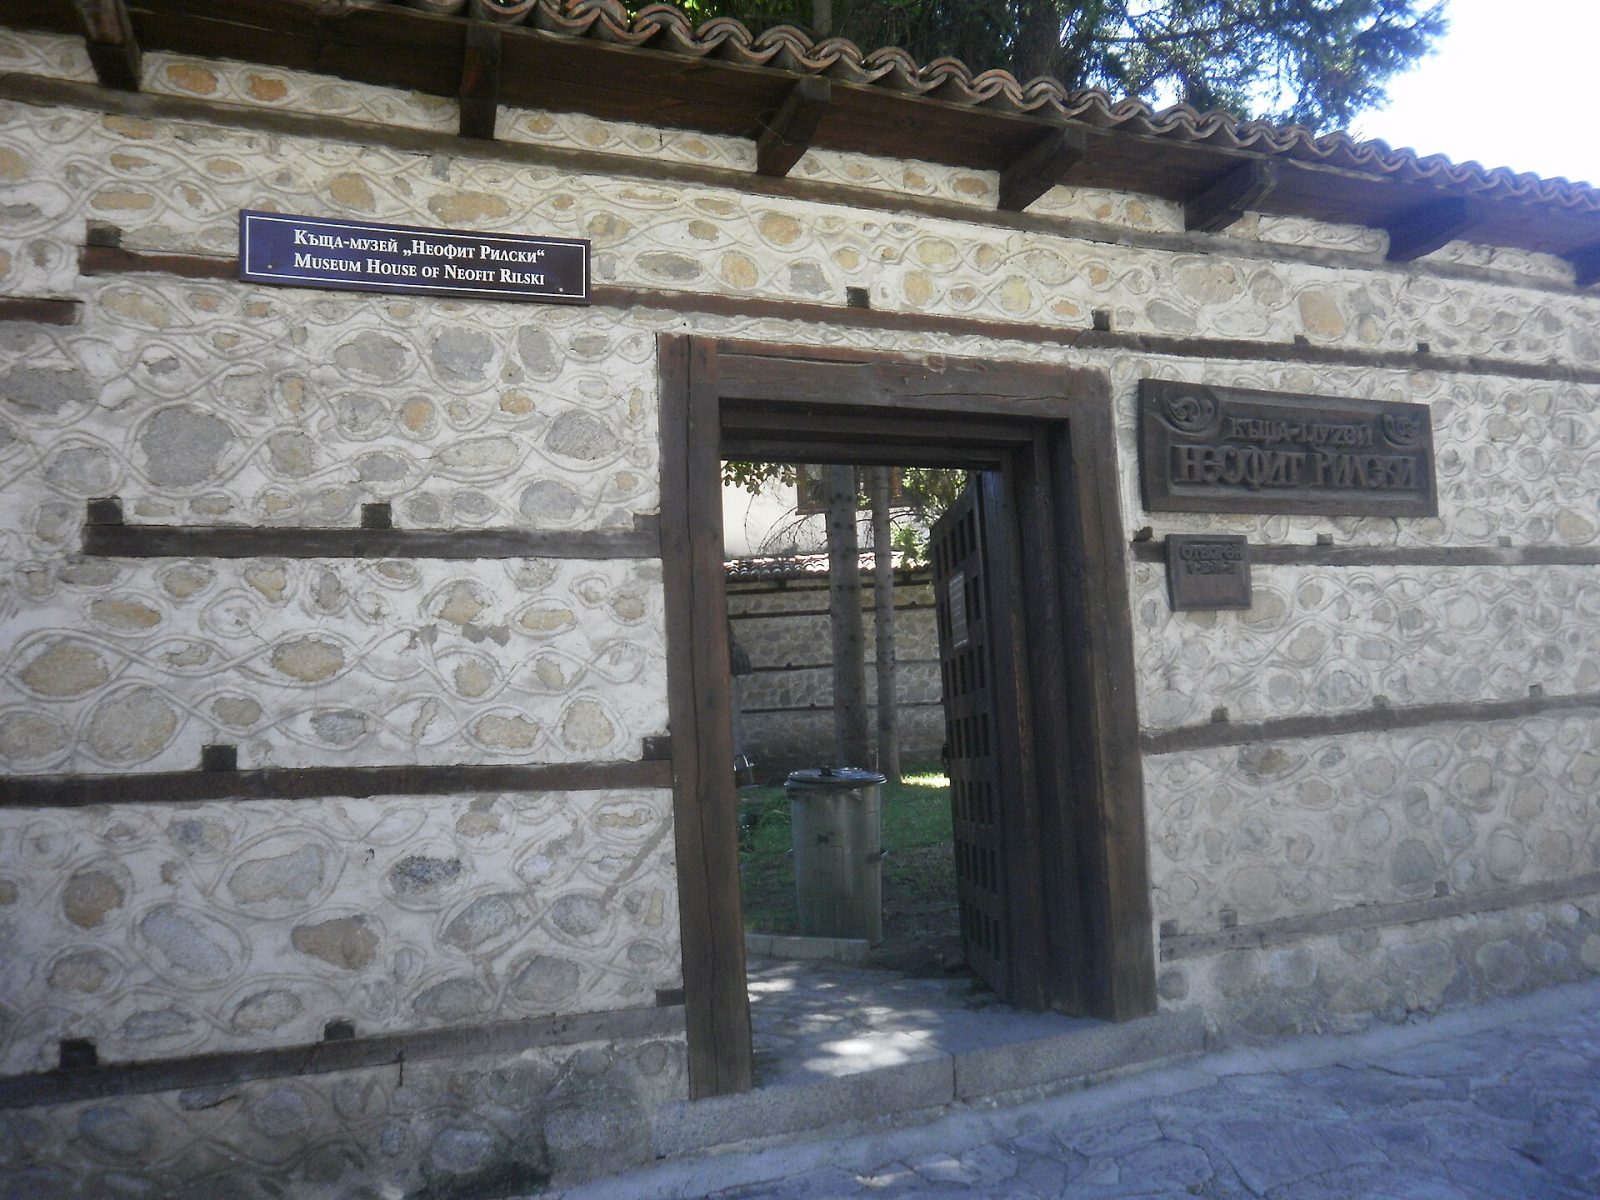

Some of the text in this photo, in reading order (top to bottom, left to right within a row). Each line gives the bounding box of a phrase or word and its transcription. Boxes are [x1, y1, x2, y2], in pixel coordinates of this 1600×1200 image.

[294, 229, 398, 253] КЪЩА-МУЗЕЙ
[294, 252, 545, 285] MUSEUM HOUSE OF NEOFIT RILSKI
